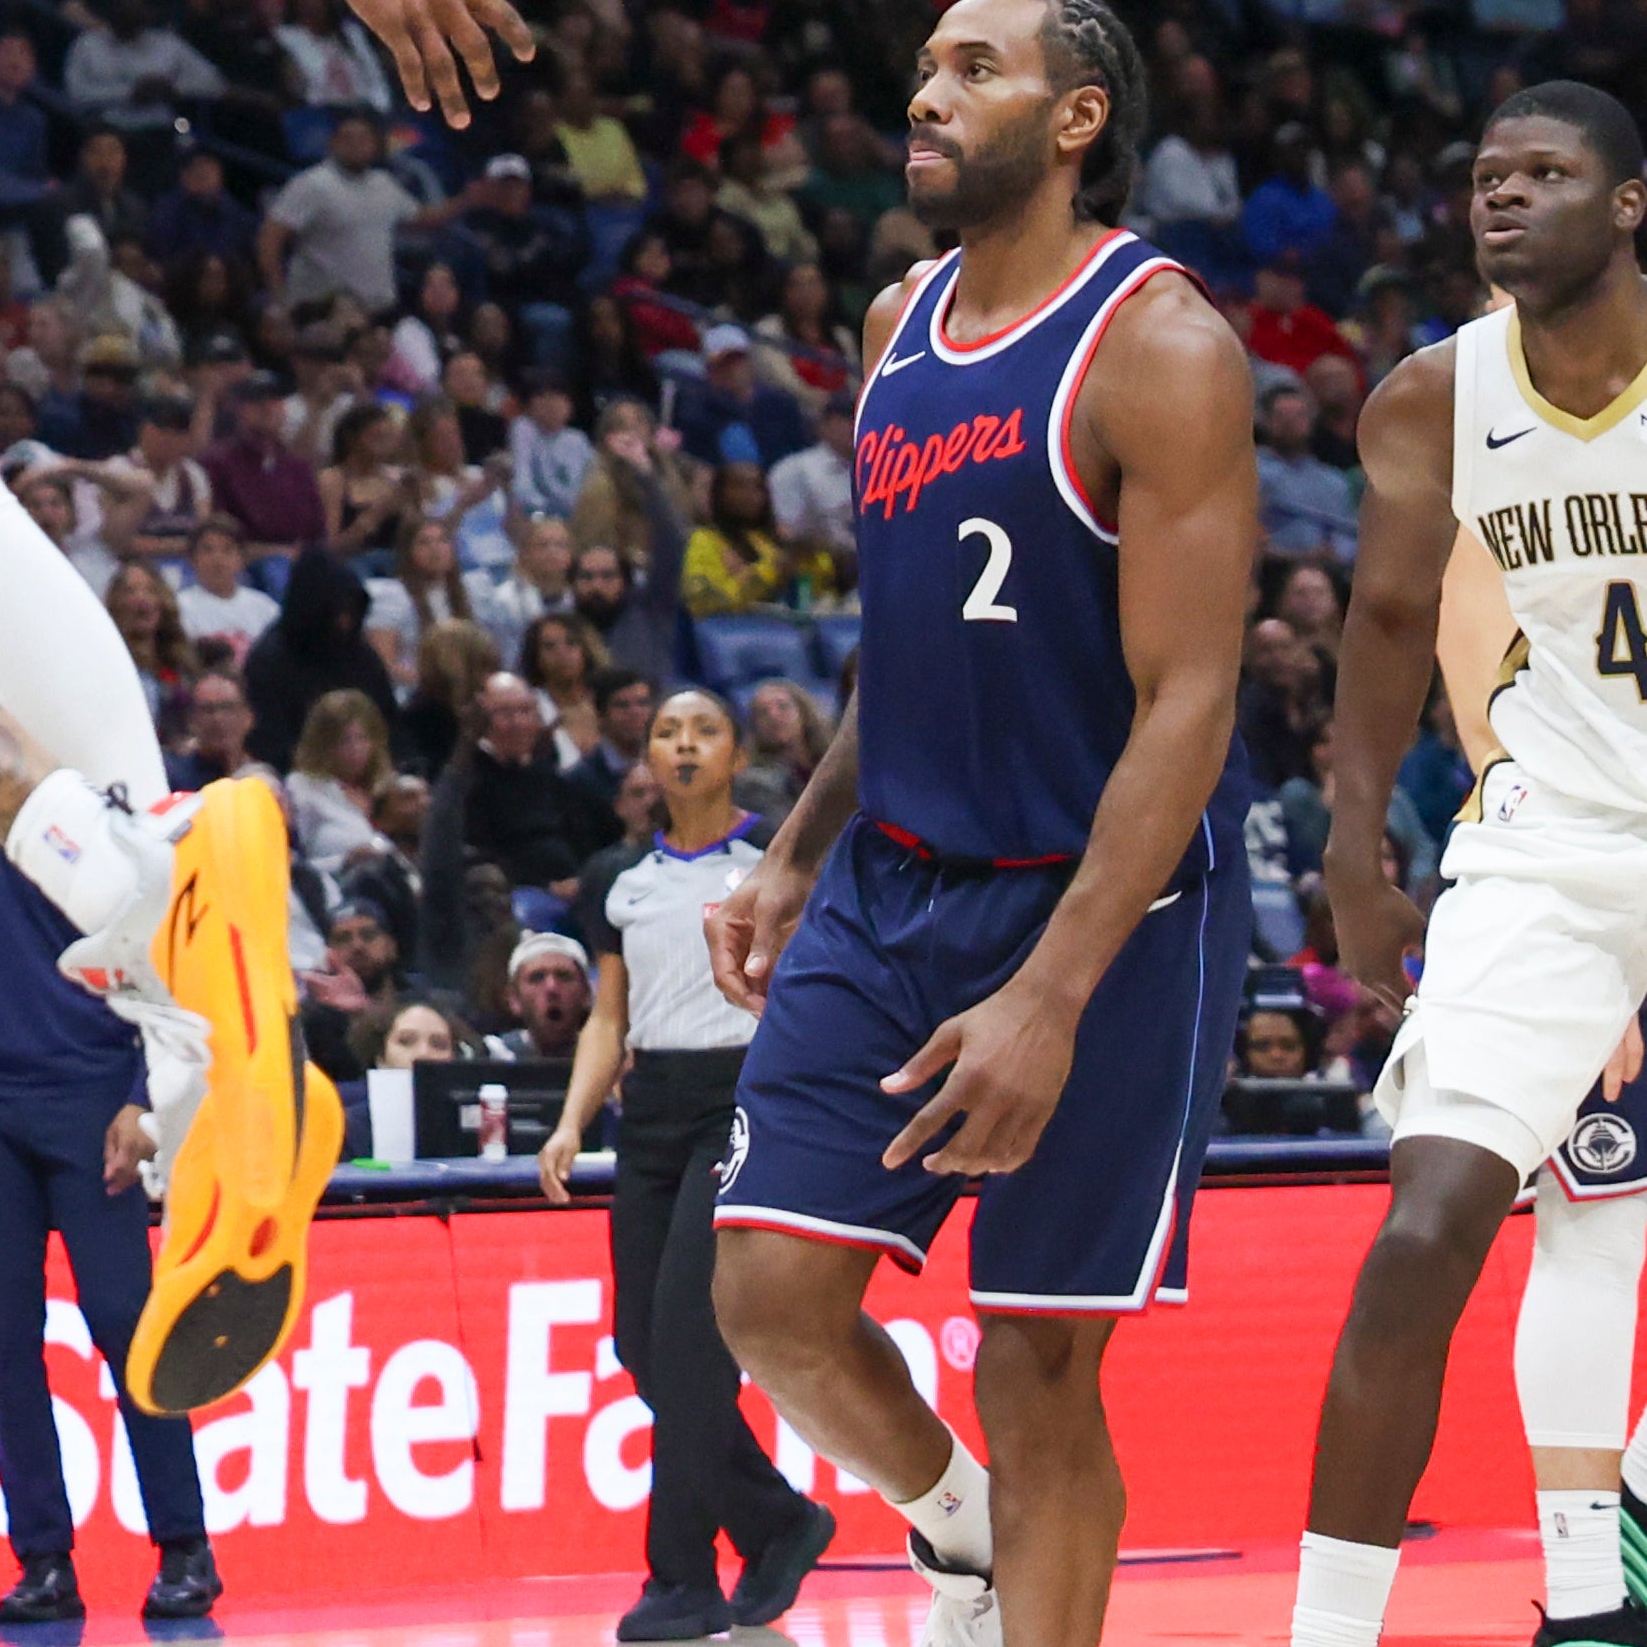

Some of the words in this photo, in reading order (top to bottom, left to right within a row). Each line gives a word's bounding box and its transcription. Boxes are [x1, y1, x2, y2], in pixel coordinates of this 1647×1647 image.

[854, 406, 1028, 520] Clippers
[957, 517, 1020, 623] 2
[1476, 496, 1554, 573] NEW
